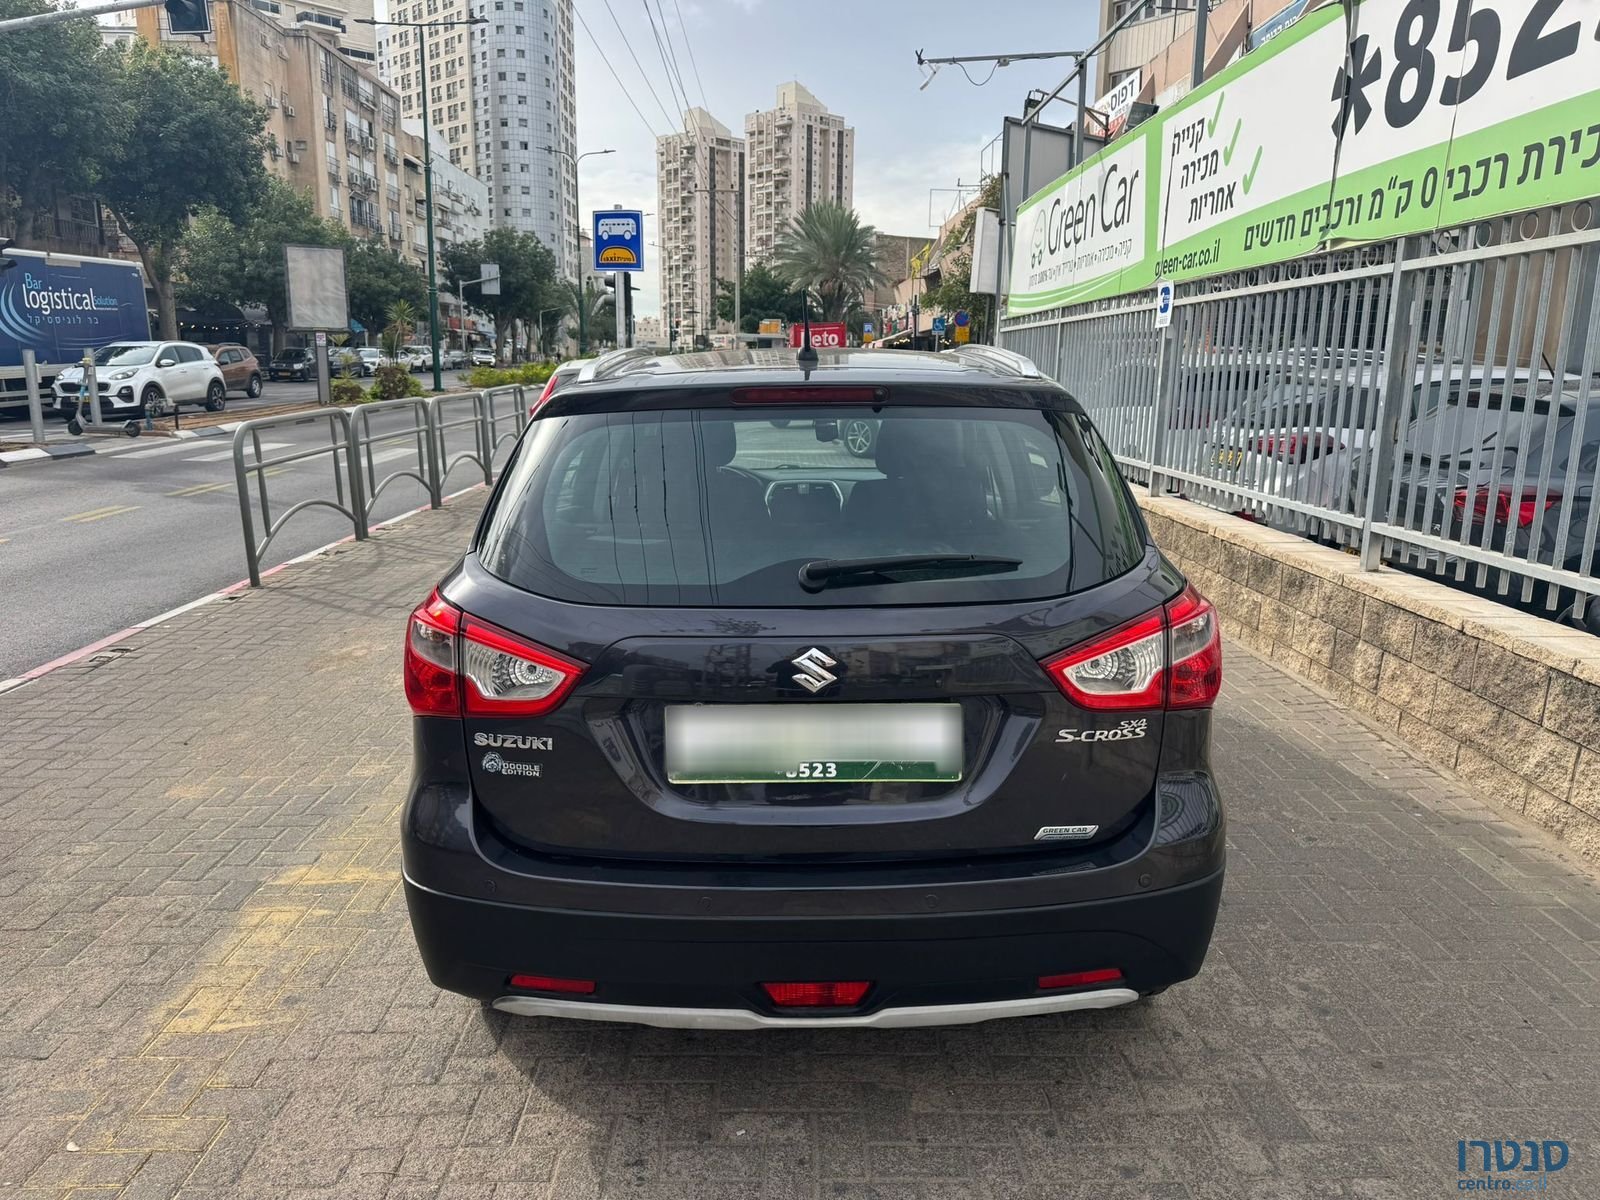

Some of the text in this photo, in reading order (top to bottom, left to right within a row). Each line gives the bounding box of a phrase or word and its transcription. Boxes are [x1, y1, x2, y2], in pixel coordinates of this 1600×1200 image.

[1331, 0, 1600, 140] 852
[1111, 79, 1135, 111] דפוס
[1172, 117, 1205, 157] קנייה
[1181, 149, 1219, 189] מכירה
[1420, 166, 1438, 209] 0
[1446, 152, 1510, 202] רכבי
[1048, 163, 1140, 256] Green Car
[1188, 181, 1237, 224] אחריות
[1300, 194, 1363, 238] ורכבים
[1244, 214, 1296, 251] חדשים
[22, 283, 119, 315] logistical Solution
[25, 272, 42, 289] Bar
[474, 732, 553, 751] SUZUKI
[1055, 727, 1147, 743] S-CROSS
[1118, 718, 1148, 730] SX4
[501, 769, 540, 777] EDITION
[502, 762, 540, 772] DOODLE
